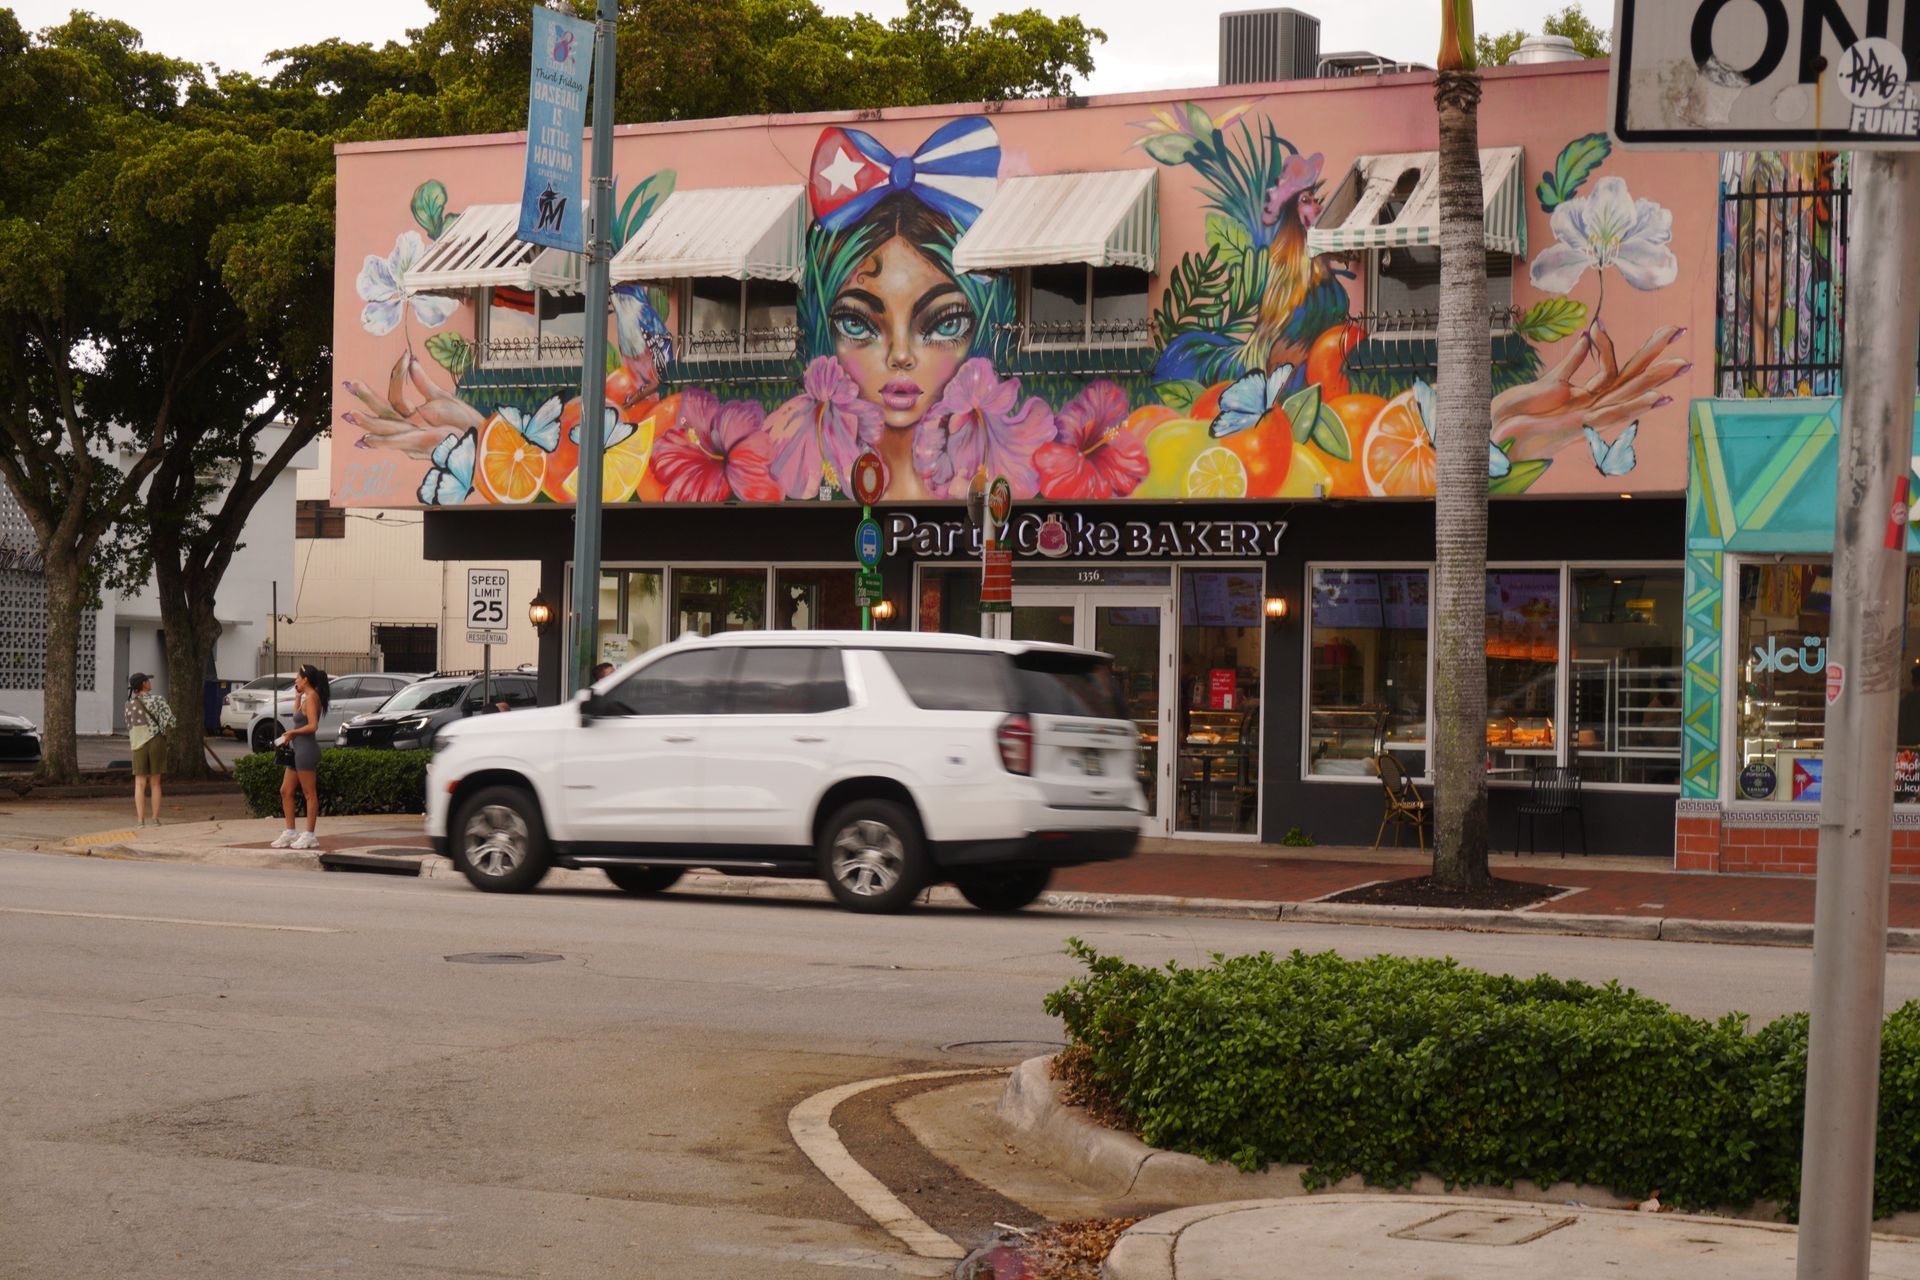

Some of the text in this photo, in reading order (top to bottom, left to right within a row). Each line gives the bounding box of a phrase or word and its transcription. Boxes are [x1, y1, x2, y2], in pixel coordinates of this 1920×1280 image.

[1690, 0, 1920, 85] ON
[536, 68, 557, 83] Third
[559, 74, 583, 94] Fridays
[534, 80, 580, 112] BASEBALL
[552, 107, 563, 127] IS
[1851, 107, 1919, 135] FUME
[541, 126, 570, 150] LITTLE
[534, 144, 573, 173] HAVANA
[1124, 521, 1288, 556] BAKERY
[471, 575, 506, 586] SPEED
[1078, 569, 1100, 583] 1356
[474, 588, 502, 598] LIMIT
[472, 600, 504, 622] 25
[468, 633, 505, 643] RESIDENTIAL
